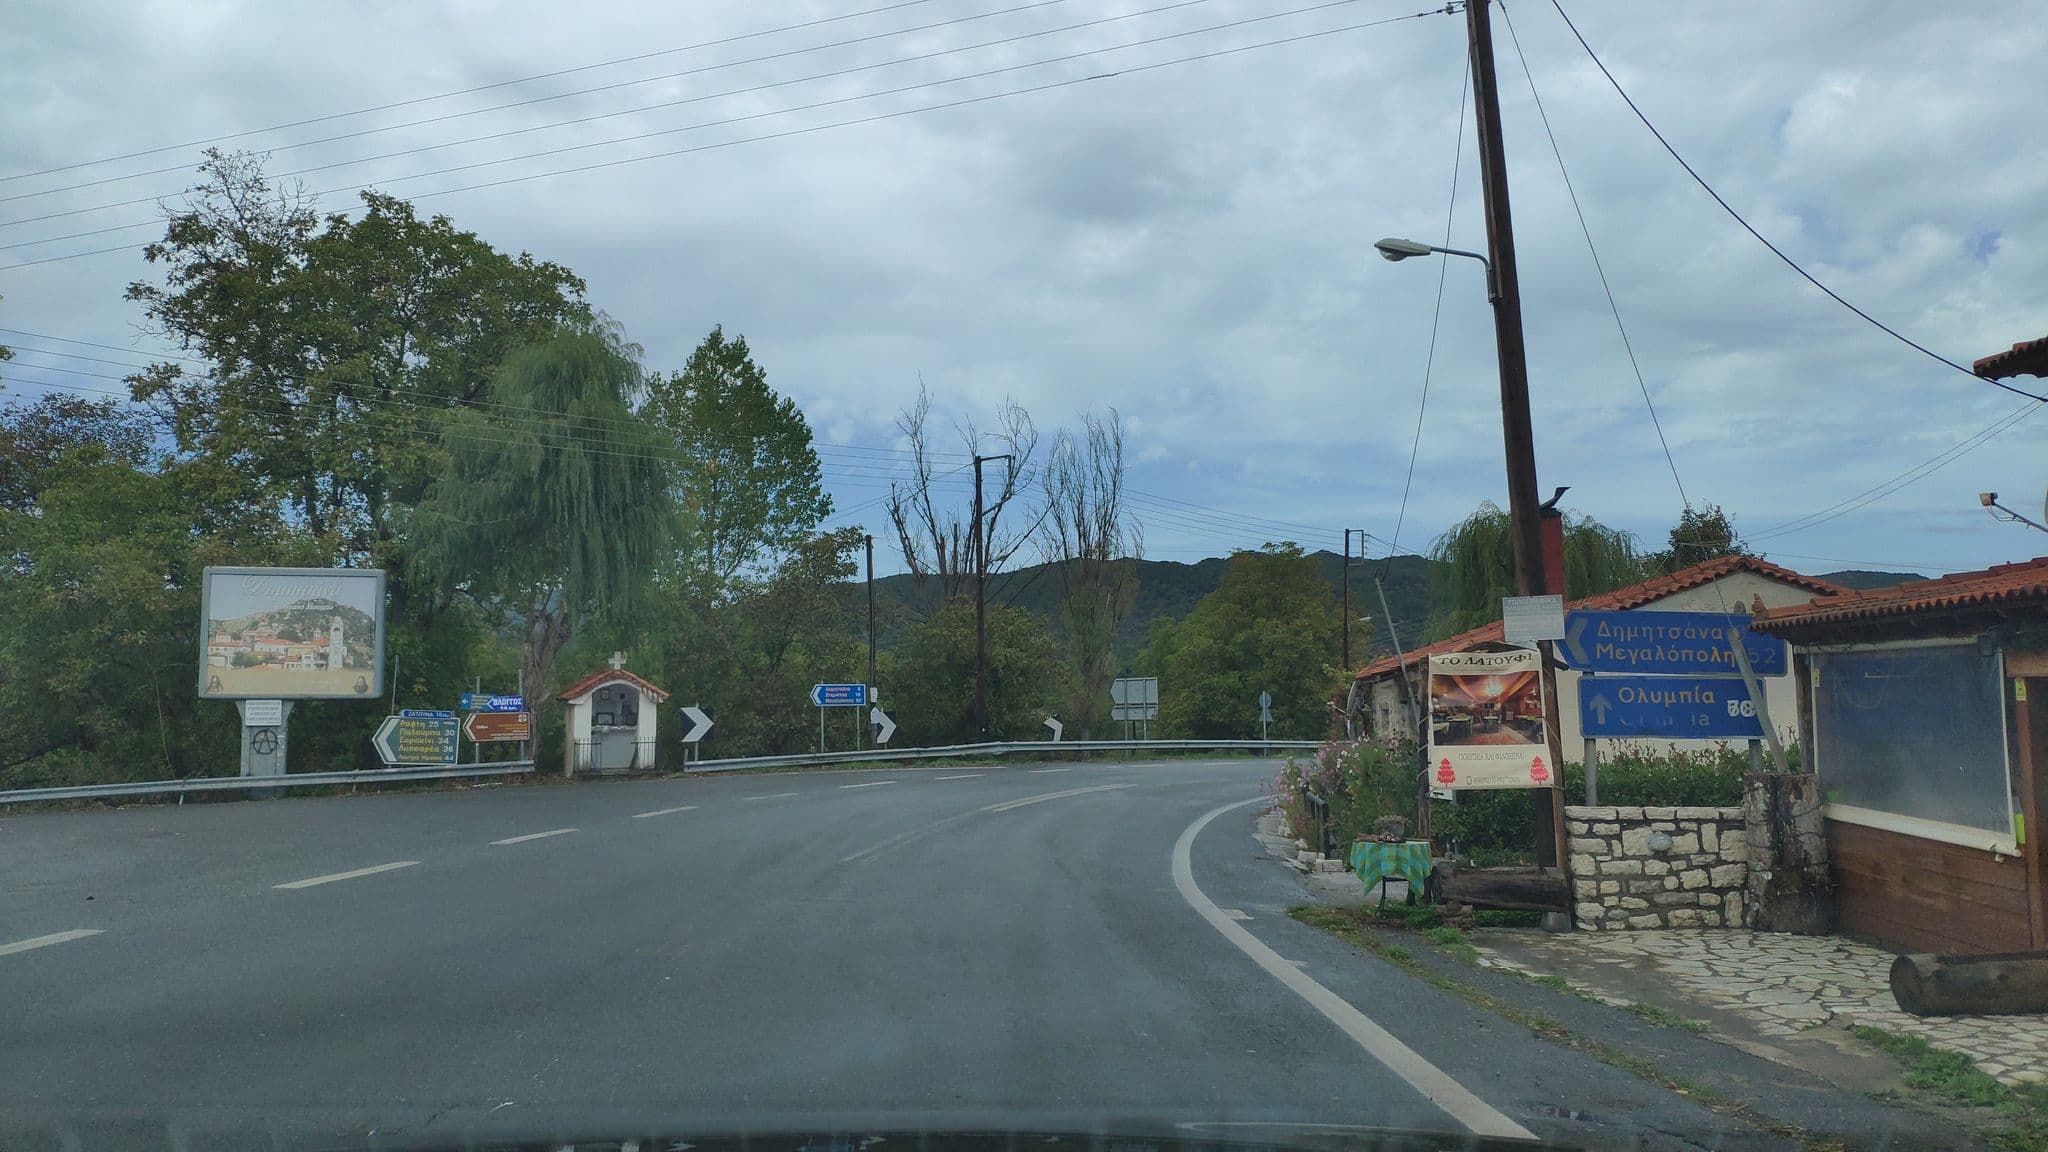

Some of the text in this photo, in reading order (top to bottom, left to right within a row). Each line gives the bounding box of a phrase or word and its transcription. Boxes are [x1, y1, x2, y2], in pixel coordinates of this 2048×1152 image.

[1597, 620, 1723, 643] Δημητσάνα
[1596, 642, 1736, 668] Μεγαλόπολη
[1618, 685, 1715, 708] Ολυμπία
[444, 729, 455, 737] 30
